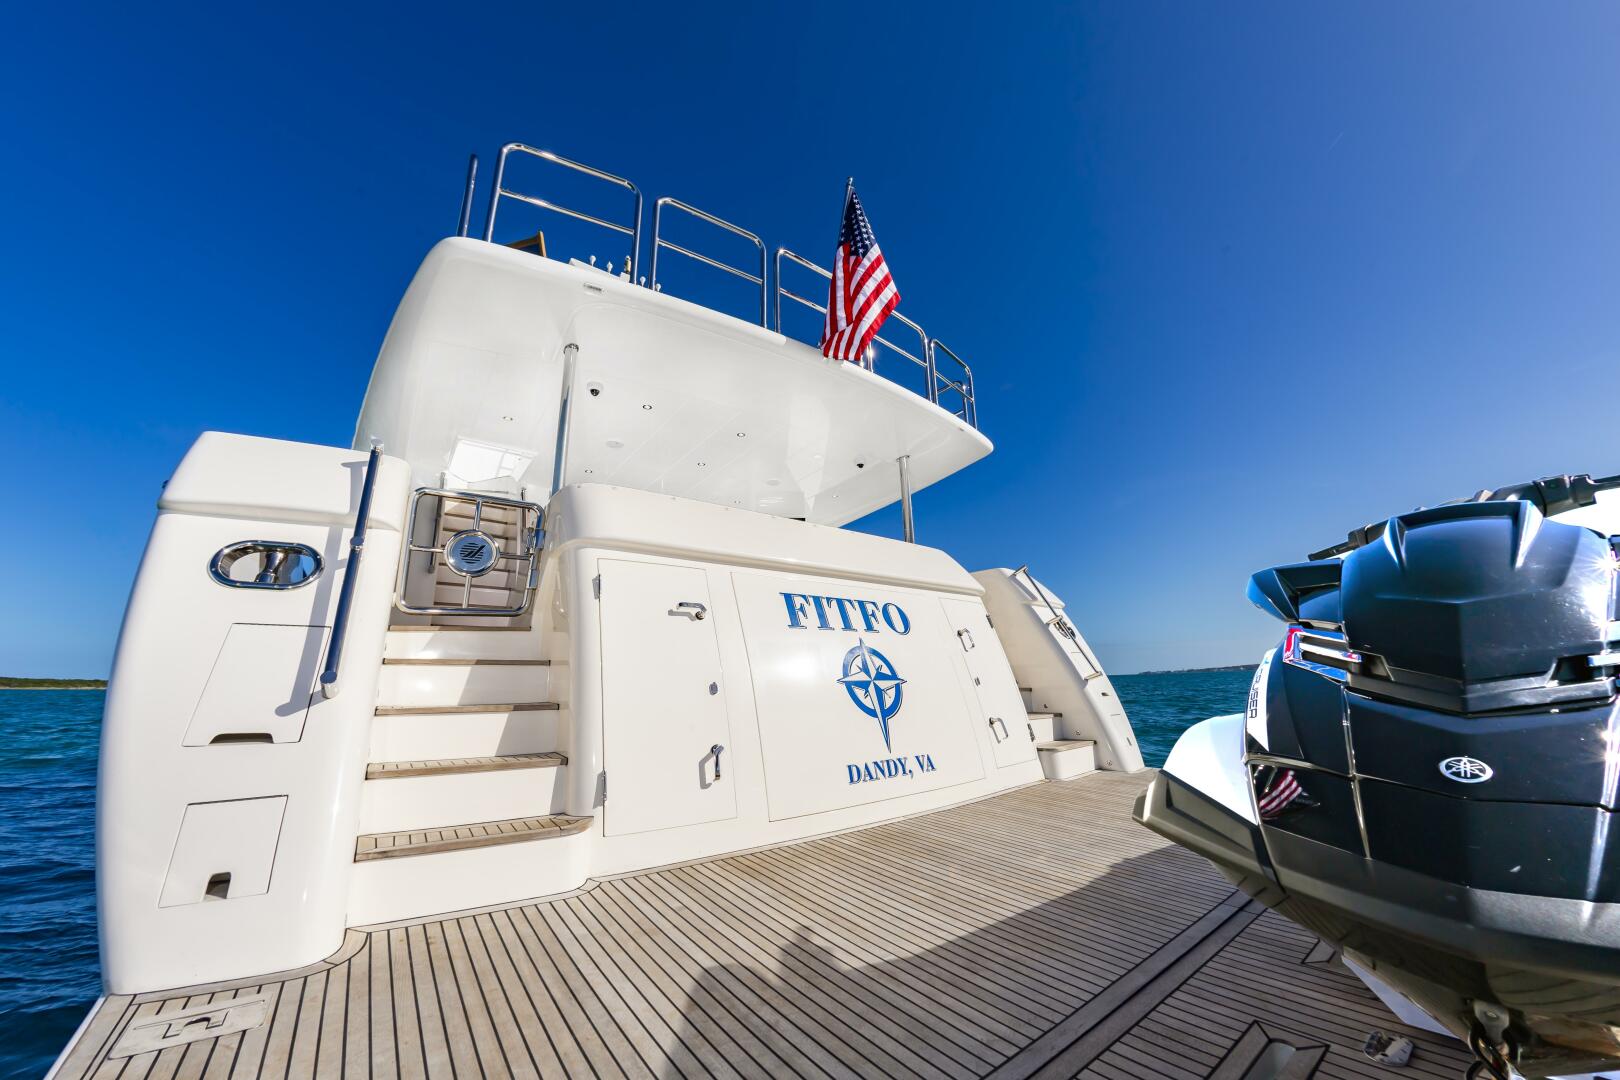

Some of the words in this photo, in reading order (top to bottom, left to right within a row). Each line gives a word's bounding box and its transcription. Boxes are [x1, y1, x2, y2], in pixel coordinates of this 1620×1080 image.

[779, 592, 911, 635] FITFO
[846, 757, 913, 785] DANDY,
[915, 753, 936, 773] VA
